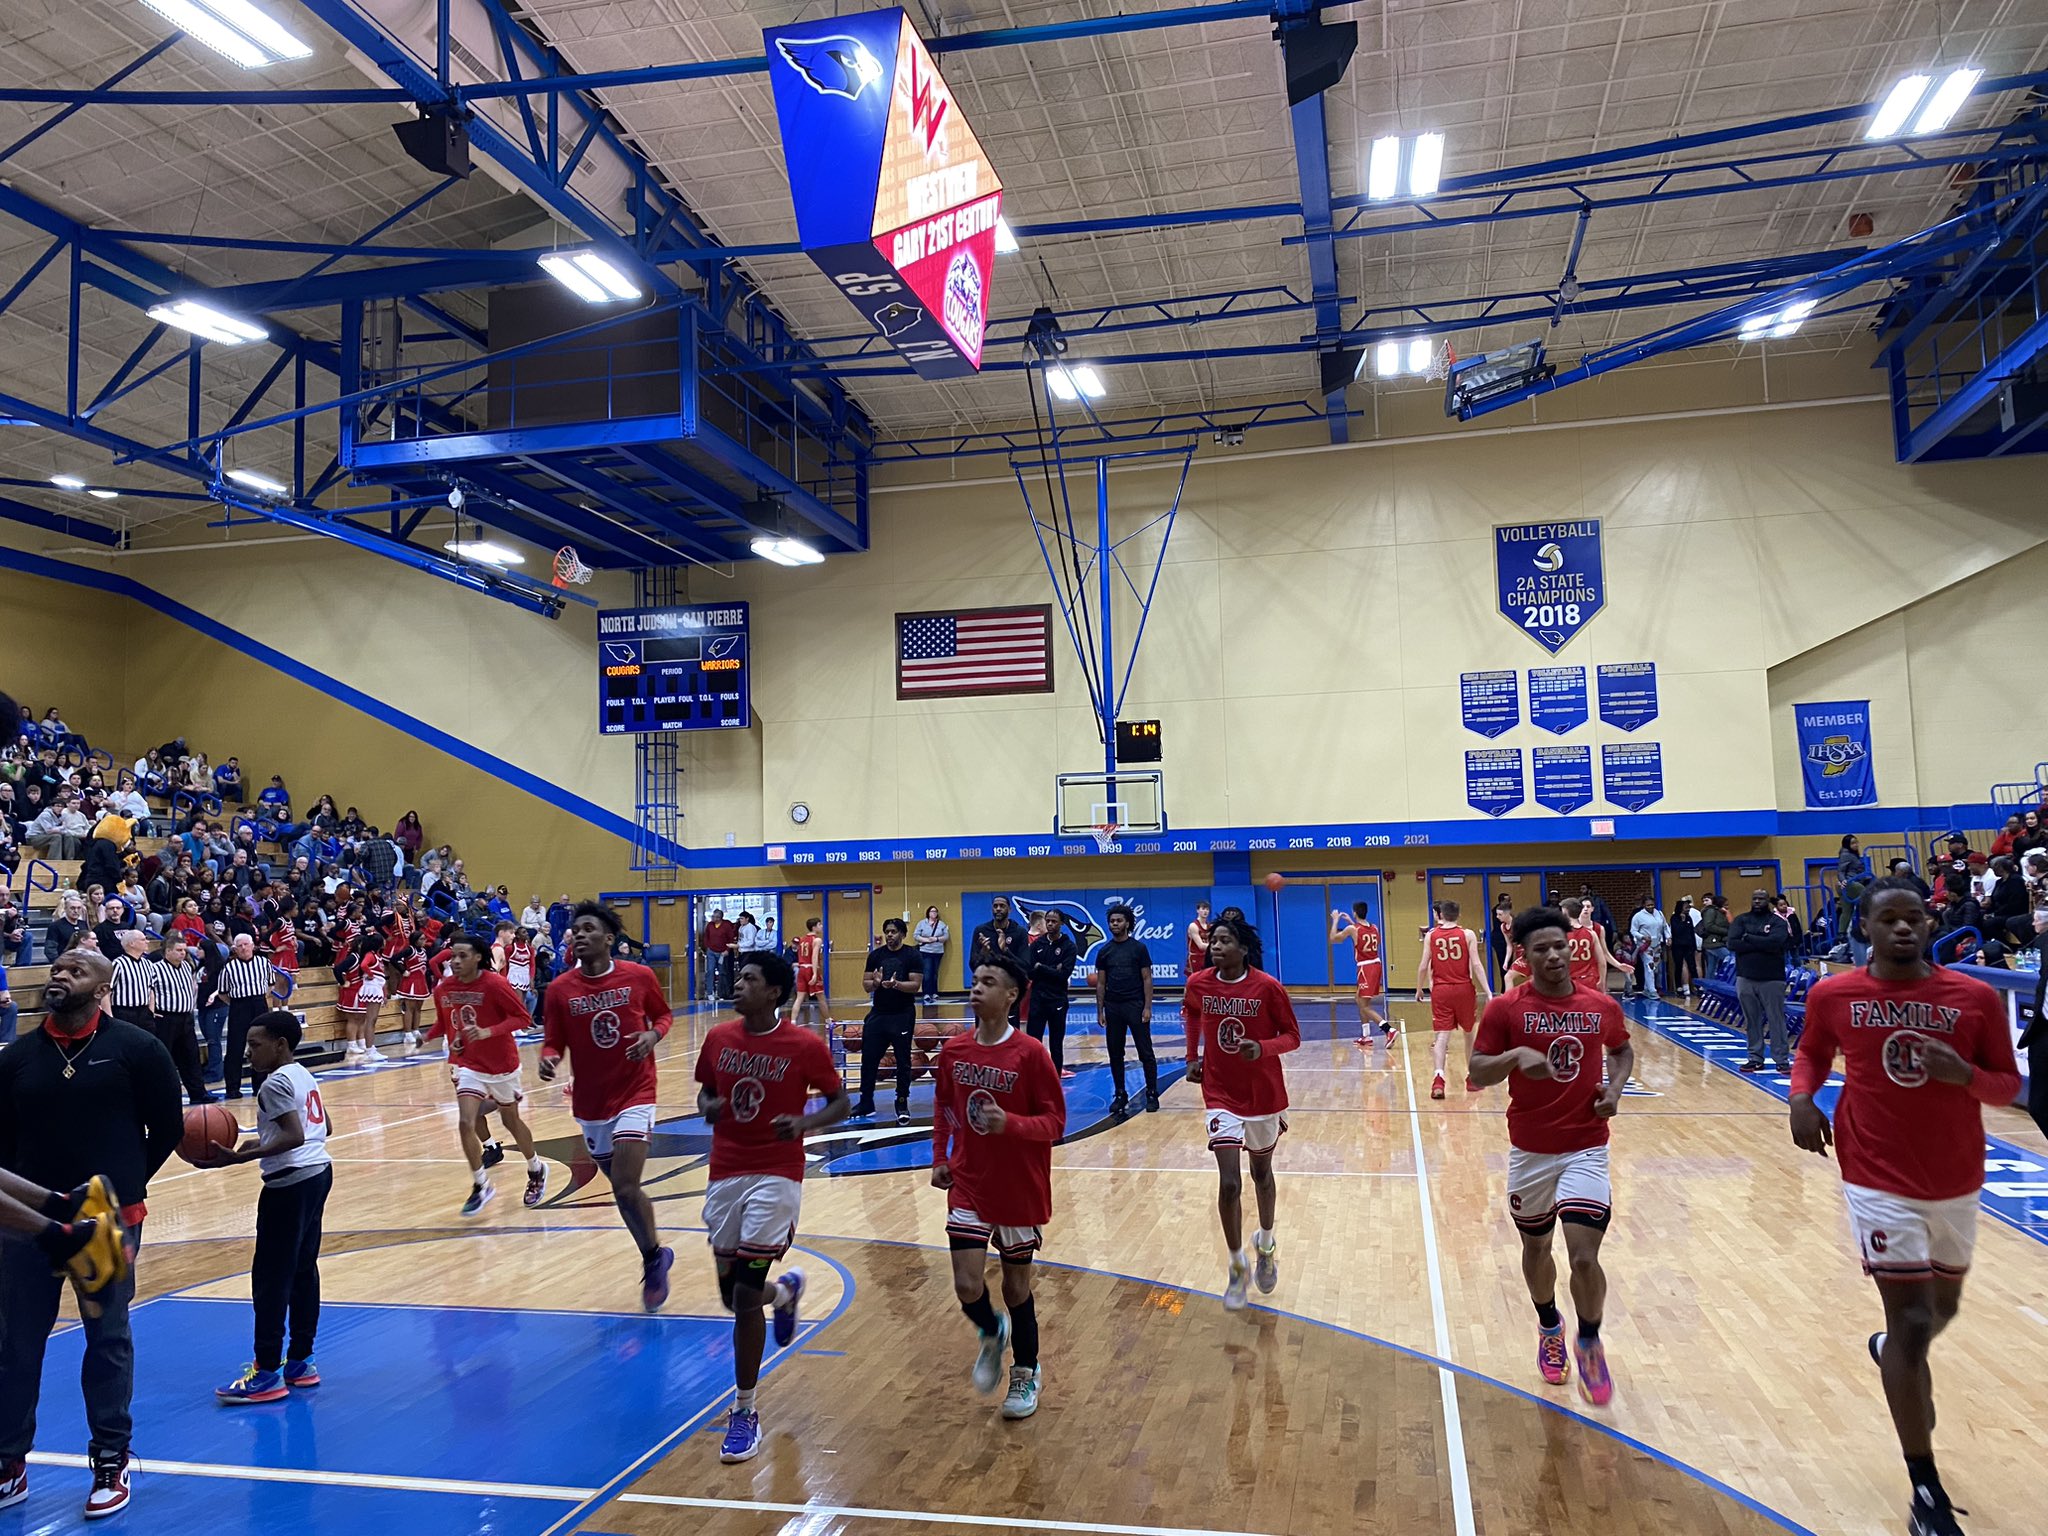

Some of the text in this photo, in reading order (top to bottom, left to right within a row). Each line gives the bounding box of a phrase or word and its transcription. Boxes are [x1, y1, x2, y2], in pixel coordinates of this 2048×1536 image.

[893, 195, 999, 271] GARY 21ST CENTURY
[1500, 522, 1596, 542] VOLLEYBALL
[1516, 573, 1585, 591] 2A STATE
[1507, 587, 1596, 607] CHAMPIONS
[600, 615, 636, 634] NORTH
[706, 609, 744, 626] PIERRE
[1523, 604, 1581, 628] 2018
[606, 665, 641, 676] COUGARS
[661, 667, 683, 676] PERIOD
[701, 659, 740, 671] WARRIORS
[606, 699, 625, 707] FOULS
[653, 695, 694, 704] PLAYER FOUL
[720, 692, 739, 701] FOULS
[606, 724, 625, 732] SCORE
[662, 721, 682, 729] MATCH
[720, 718, 740, 726] SCORE
[1803, 713, 1864, 727] MEMBER
[1810, 742, 1863, 763] IHSAA
[1819, 790, 1837, 799] Est.
[792, 853, 814, 863] 1978
[825, 852, 847, 862] 1979
[858, 851, 881, 861] 1983
[925, 848, 947, 859] 1987
[993, 846, 1016, 857] 1996
[1028, 845, 1050, 856] 1997
[1062, 844, 1086, 855] 1998
[1134, 842, 1160, 853] 2000
[1173, 841, 1197, 852] 2001
[1209, 839, 1236, 851] 2002
[1248, 838, 1276, 849] 2005
[1288, 837, 1314, 848] 2015
[1326, 836, 1351, 847] 2018
[1364, 835, 1390, 846] 2019
[1403, 834, 1429, 845] 2021
[1362, 934, 1378, 951] 25
[1435, 936, 1462, 961] 35
[1569, 938, 1591, 961] 23
[568, 986, 631, 1016] FAMILY
[1202, 995, 1261, 1016] FAMILY
[1524, 1011, 1602, 1034] FAMILY
[1850, 1000, 1961, 1034] FAMILY
[717, 1047, 792, 1082] FAMILY
[952, 1060, 1019, 1093] FAMILY
